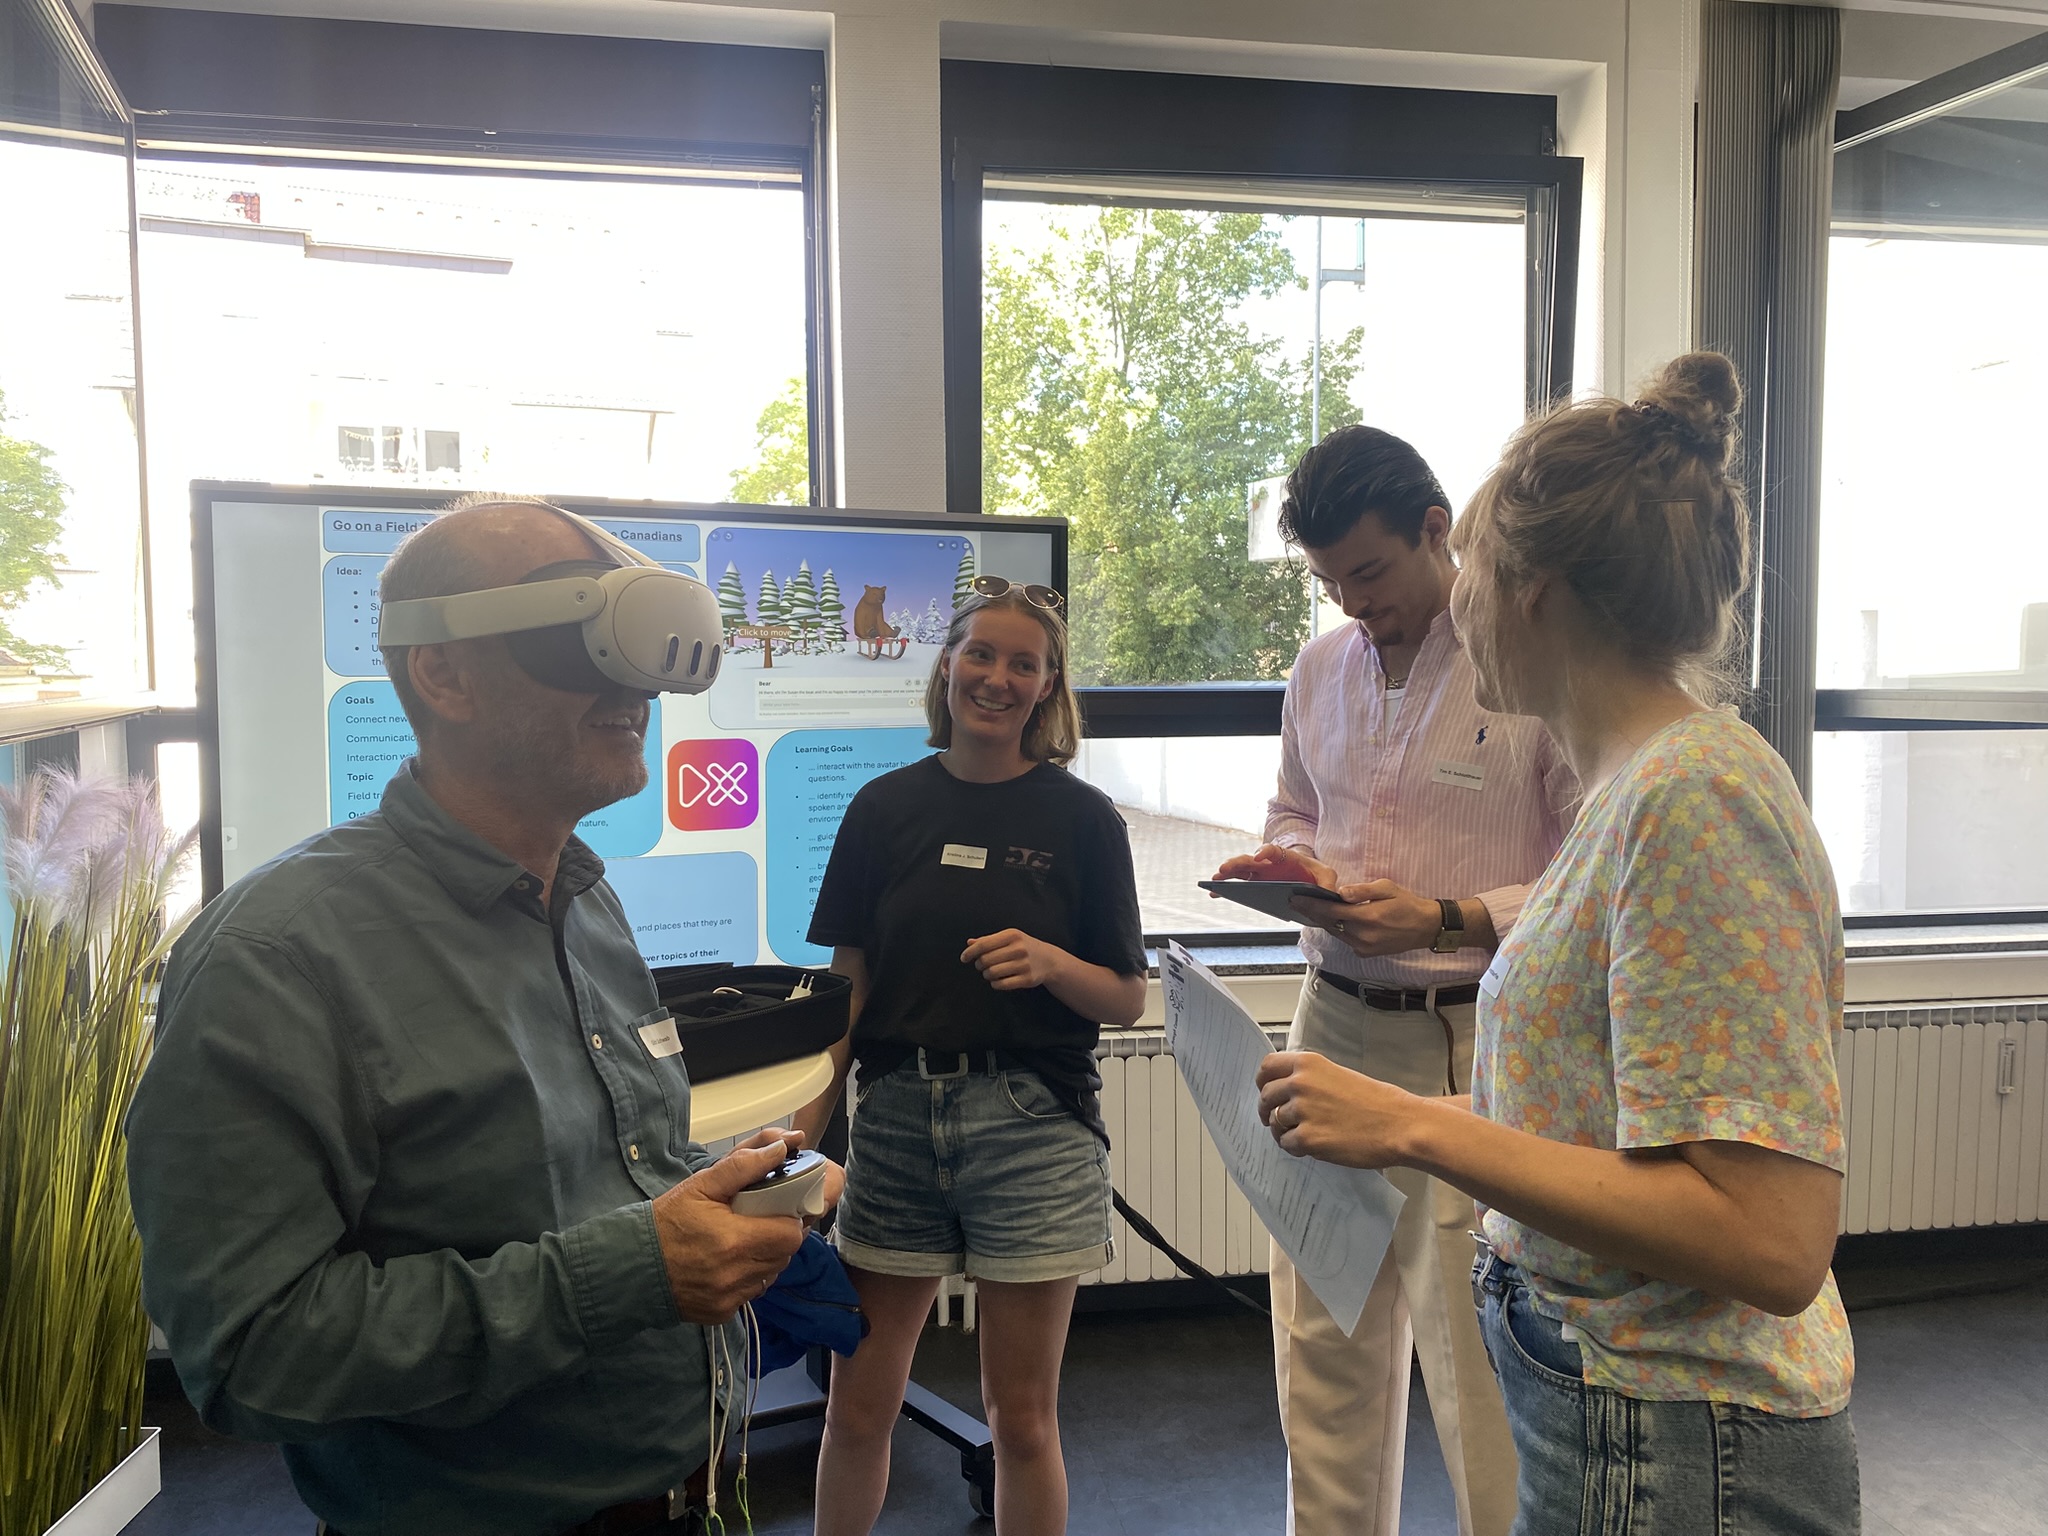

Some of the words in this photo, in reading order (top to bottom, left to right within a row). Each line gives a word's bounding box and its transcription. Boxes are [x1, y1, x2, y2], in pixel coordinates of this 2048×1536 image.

[332, 520, 352, 532] Go
[355, 522, 372, 532] on
[375, 523, 383, 532] a
[386, 521, 418, 533] Field
[620, 529, 683, 542] Canadians
[336, 567, 362, 576] Idea:
[738, 628, 758, 637] Click
[760, 629, 769, 637] to
[345, 696, 375, 705] Goals
[345, 715, 387, 724] Connect
[795, 745, 830, 754] Learning
[830, 745, 853, 753] Goals
[346, 753, 398, 762] Interaction
[817, 763, 846, 771] interact
[846, 762, 862, 770] with
[876, 761, 899, 769] avatar
[347, 773, 374, 783] Topic
[808, 775, 847, 783] questions.
[347, 792, 371, 800] Field
[817, 791, 846, 800] identify
[808, 803, 836, 813] spoken
[578, 820, 609, 828] nature,
[637, 923, 653, 932] and
[654, 922, 682, 932] places
[683, 920, 699, 929] that
[701, 919, 718, 929] they
[719, 918, 732, 926] are
[661, 952, 688, 962] topics
[689, 950, 698, 958] of
[699, 948, 720, 957] their
